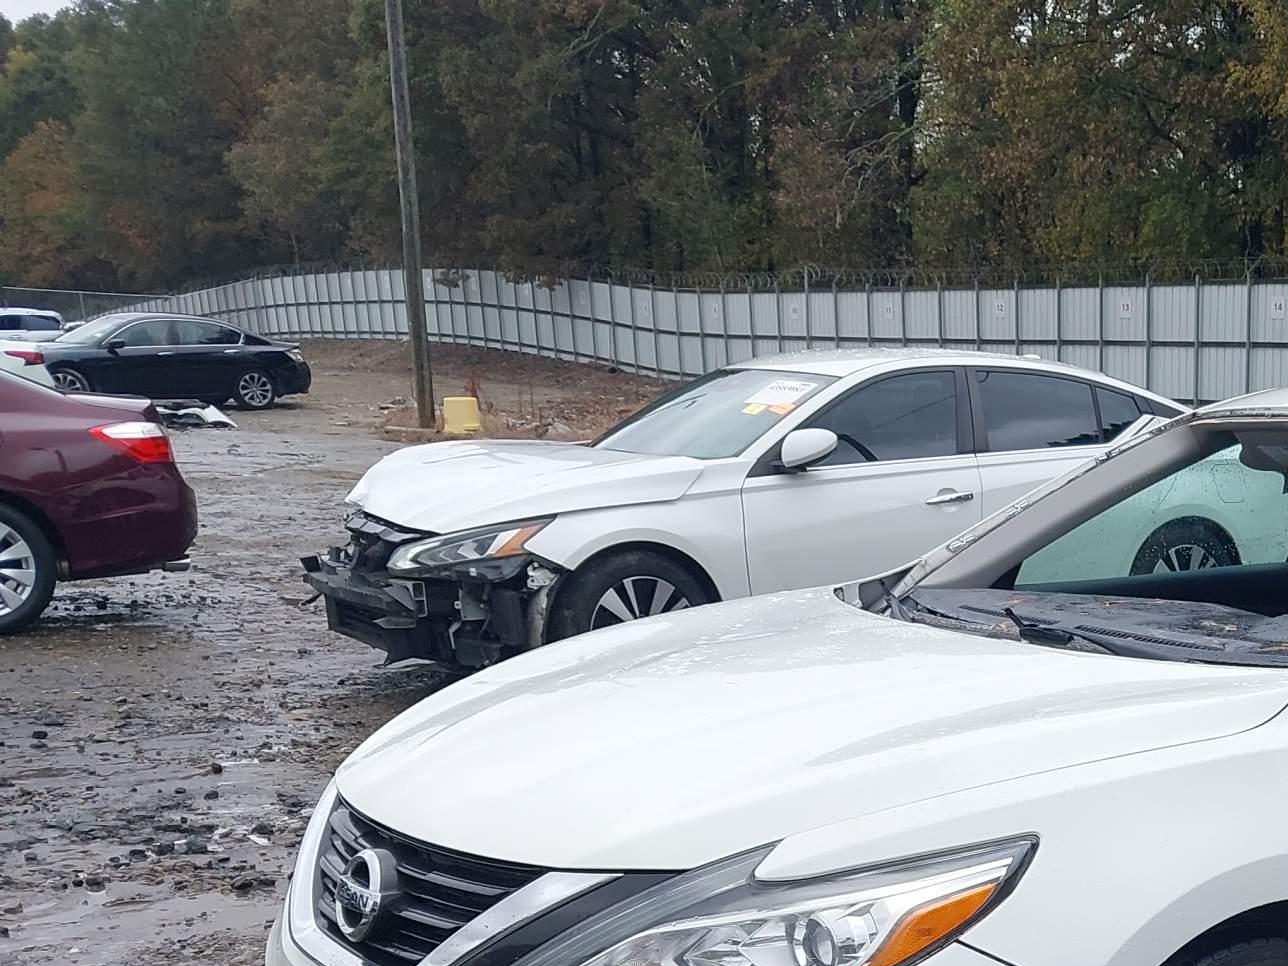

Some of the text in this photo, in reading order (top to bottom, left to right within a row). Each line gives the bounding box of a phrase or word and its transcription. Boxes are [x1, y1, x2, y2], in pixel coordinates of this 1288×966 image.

[996, 303, 1004, 312] 12
[1122, 303, 1130, 312] 13
[1274, 303, 1282, 312] 14
